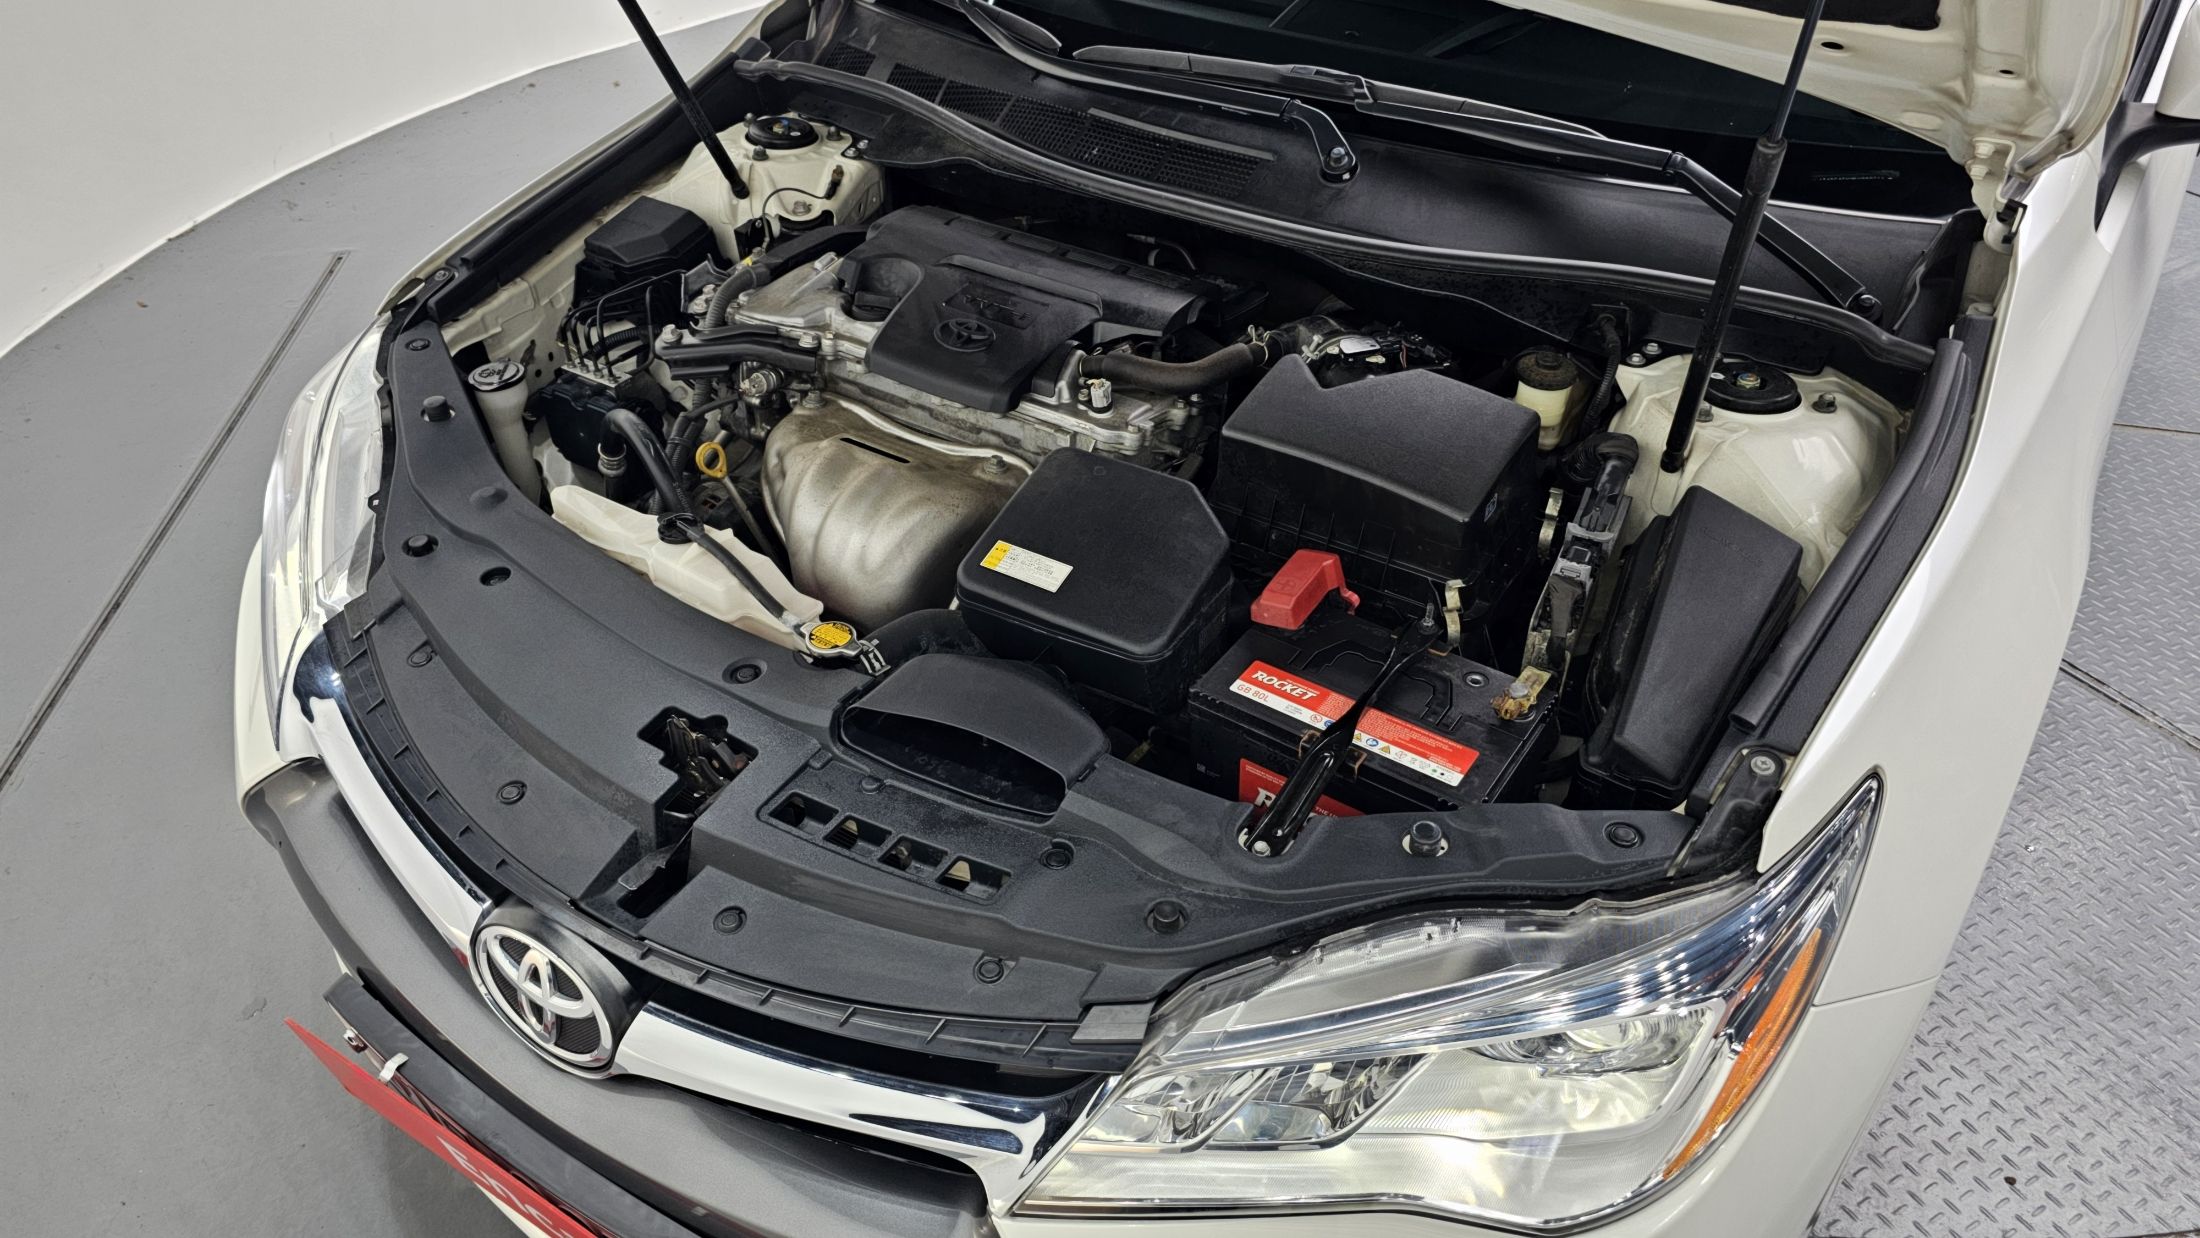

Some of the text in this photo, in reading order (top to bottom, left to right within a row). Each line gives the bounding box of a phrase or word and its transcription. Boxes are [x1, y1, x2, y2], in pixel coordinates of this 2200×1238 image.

[1236, 684, 1270, 703] GB 80L
[1251, 670, 1318, 701] ROCKET
